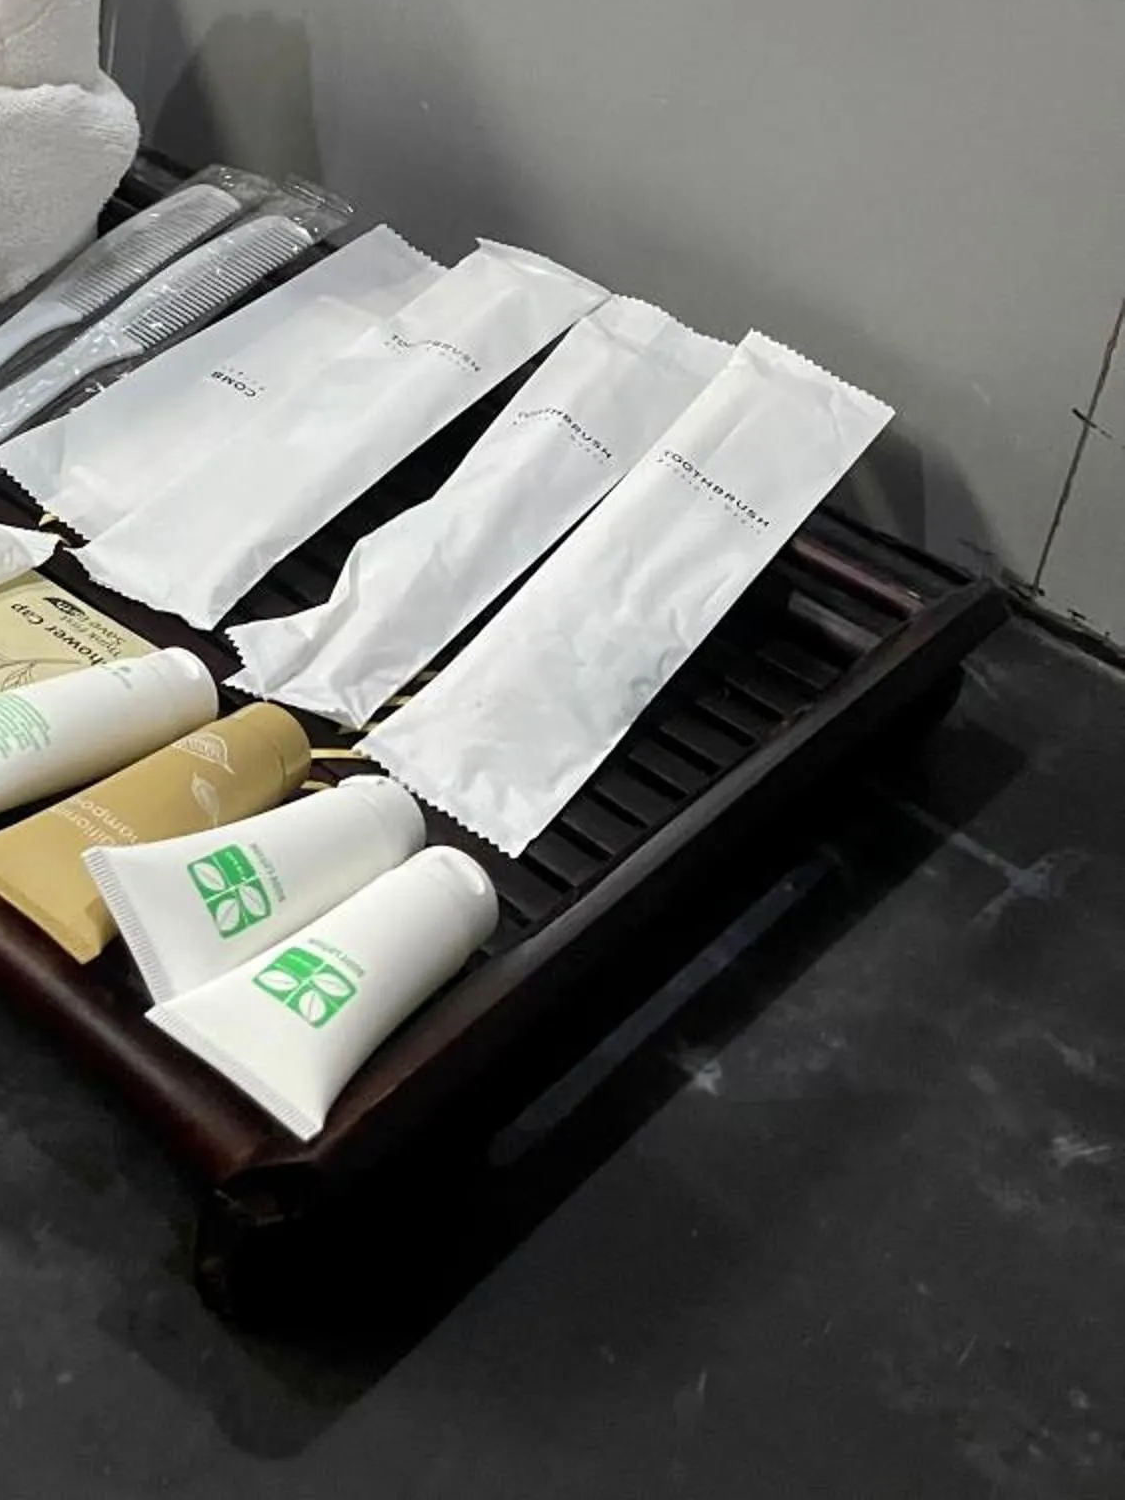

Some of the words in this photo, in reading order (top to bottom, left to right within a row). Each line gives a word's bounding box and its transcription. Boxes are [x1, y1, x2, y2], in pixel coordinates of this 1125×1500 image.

[211, 369, 259, 398] COMB
[664, 450, 770, 527] TOOTHBRUSH
[10, 601, 46, 628] Cap
[43, 624, 105, 669] hower
